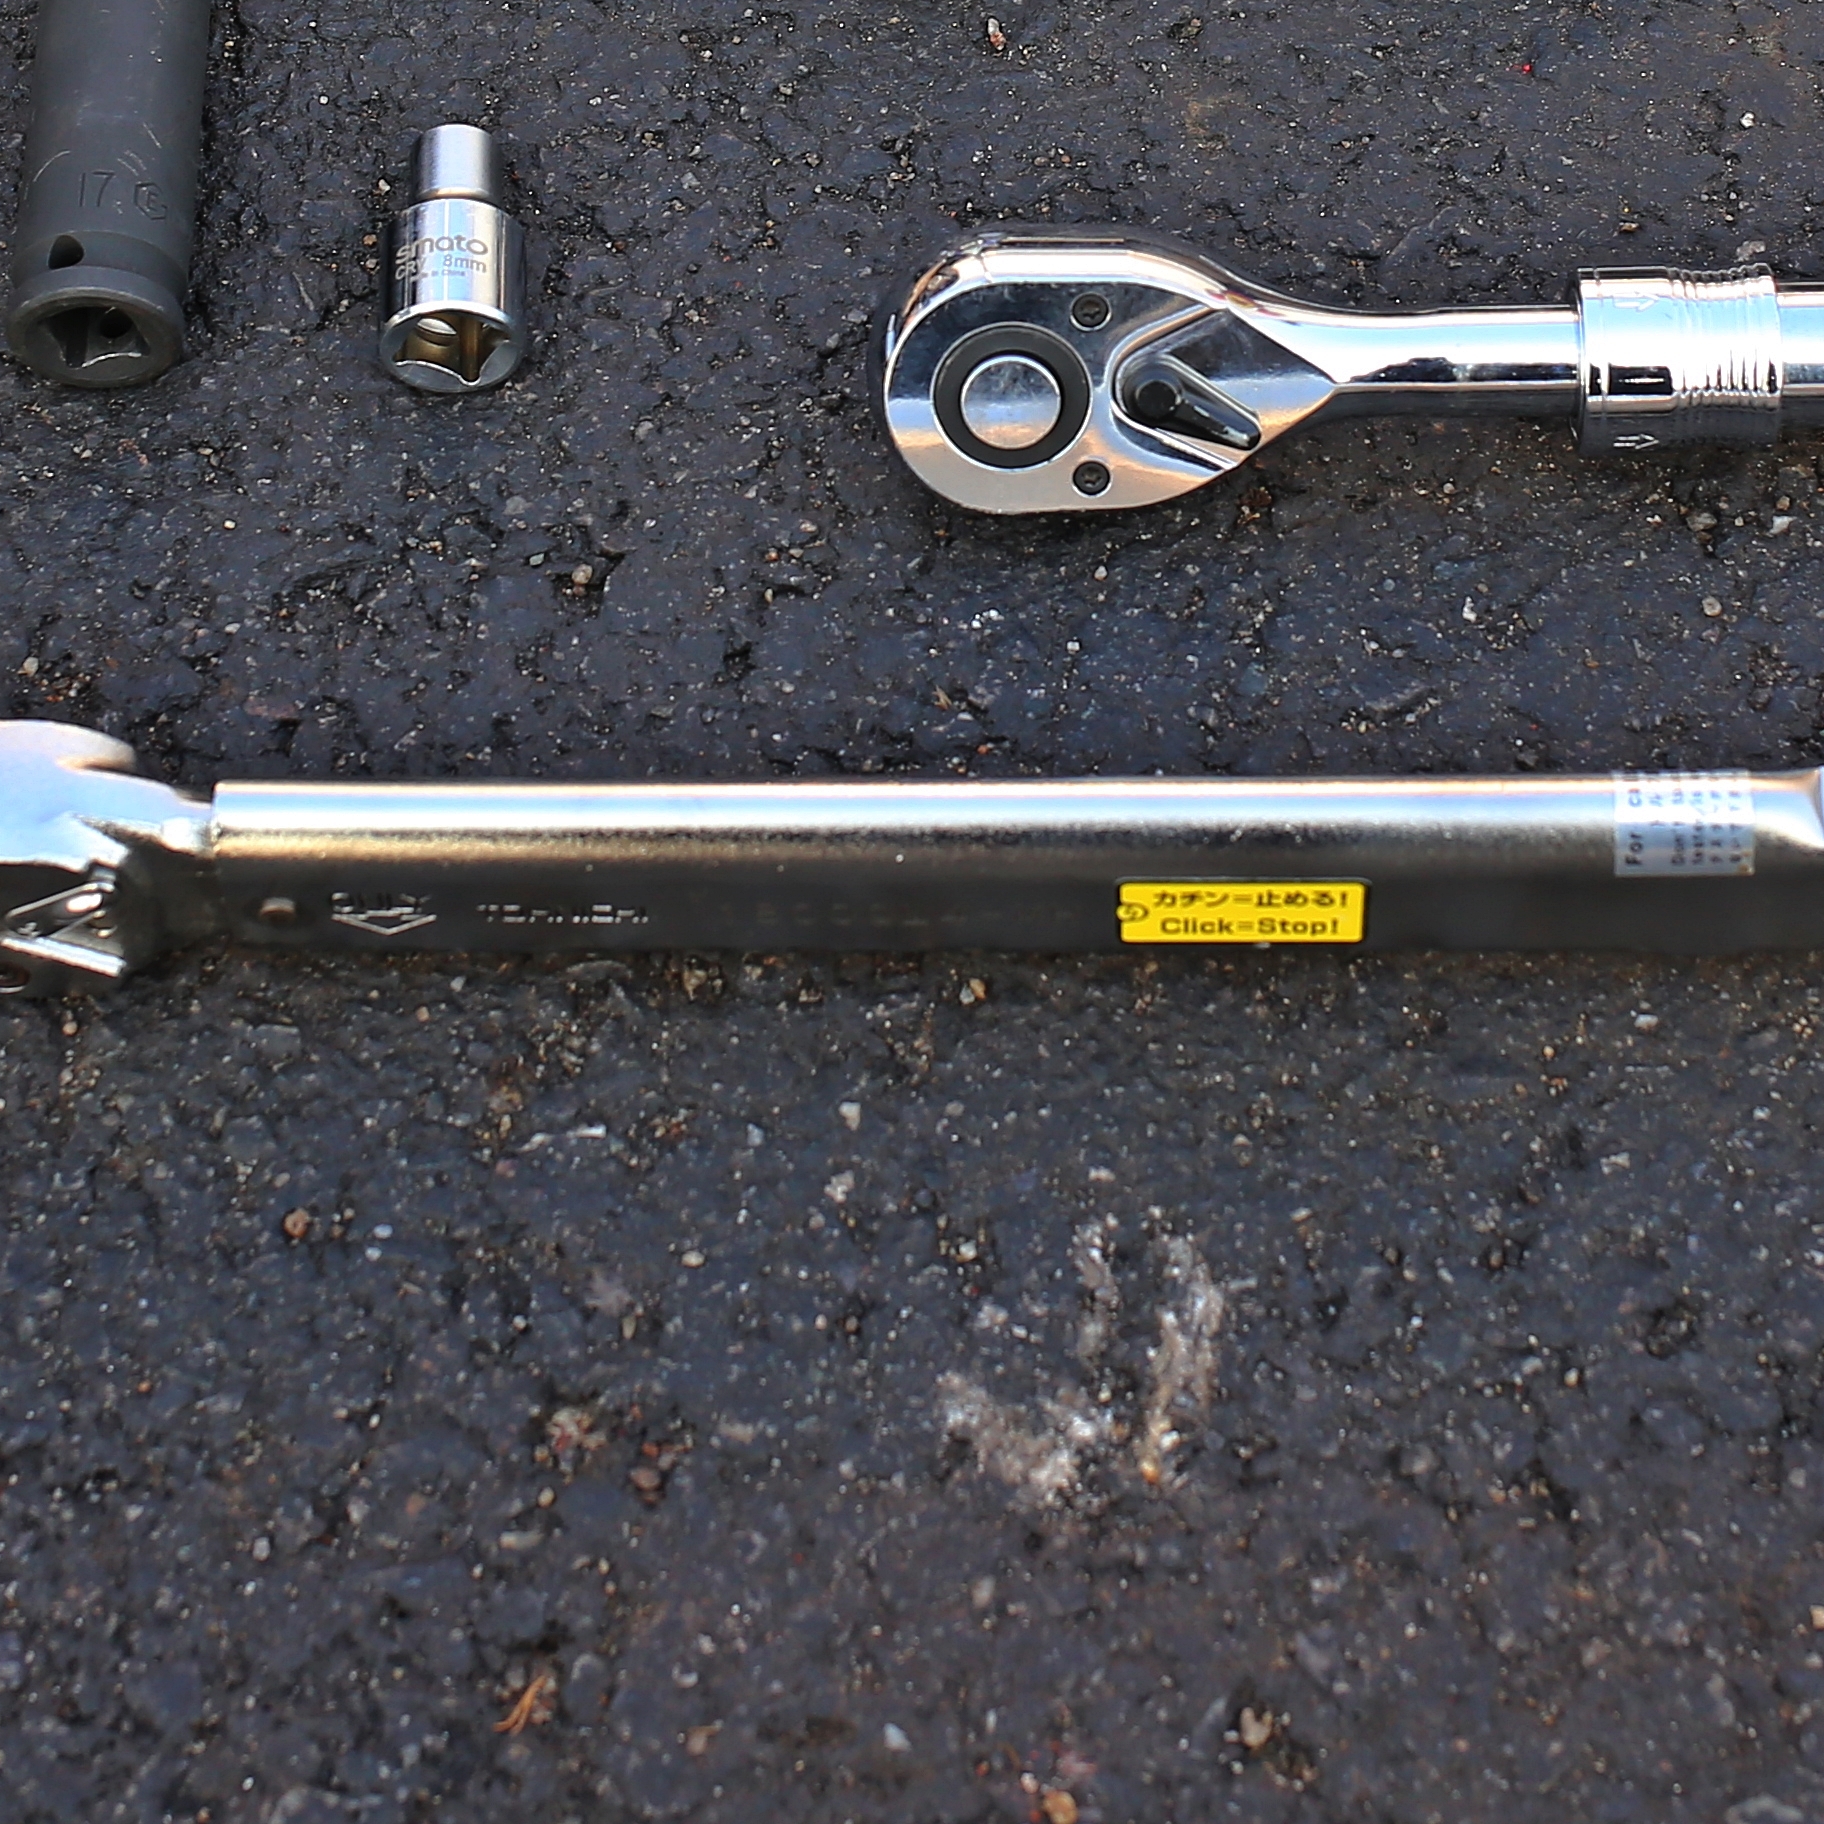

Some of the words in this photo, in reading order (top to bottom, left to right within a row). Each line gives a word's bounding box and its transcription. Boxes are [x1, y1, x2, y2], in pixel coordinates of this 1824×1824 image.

[78, 169, 117, 208] 17
[395, 234, 489, 266] smato
[442, 254, 488, 274] 8mm
[1160, 916, 1341, 937] Click=Stop!
